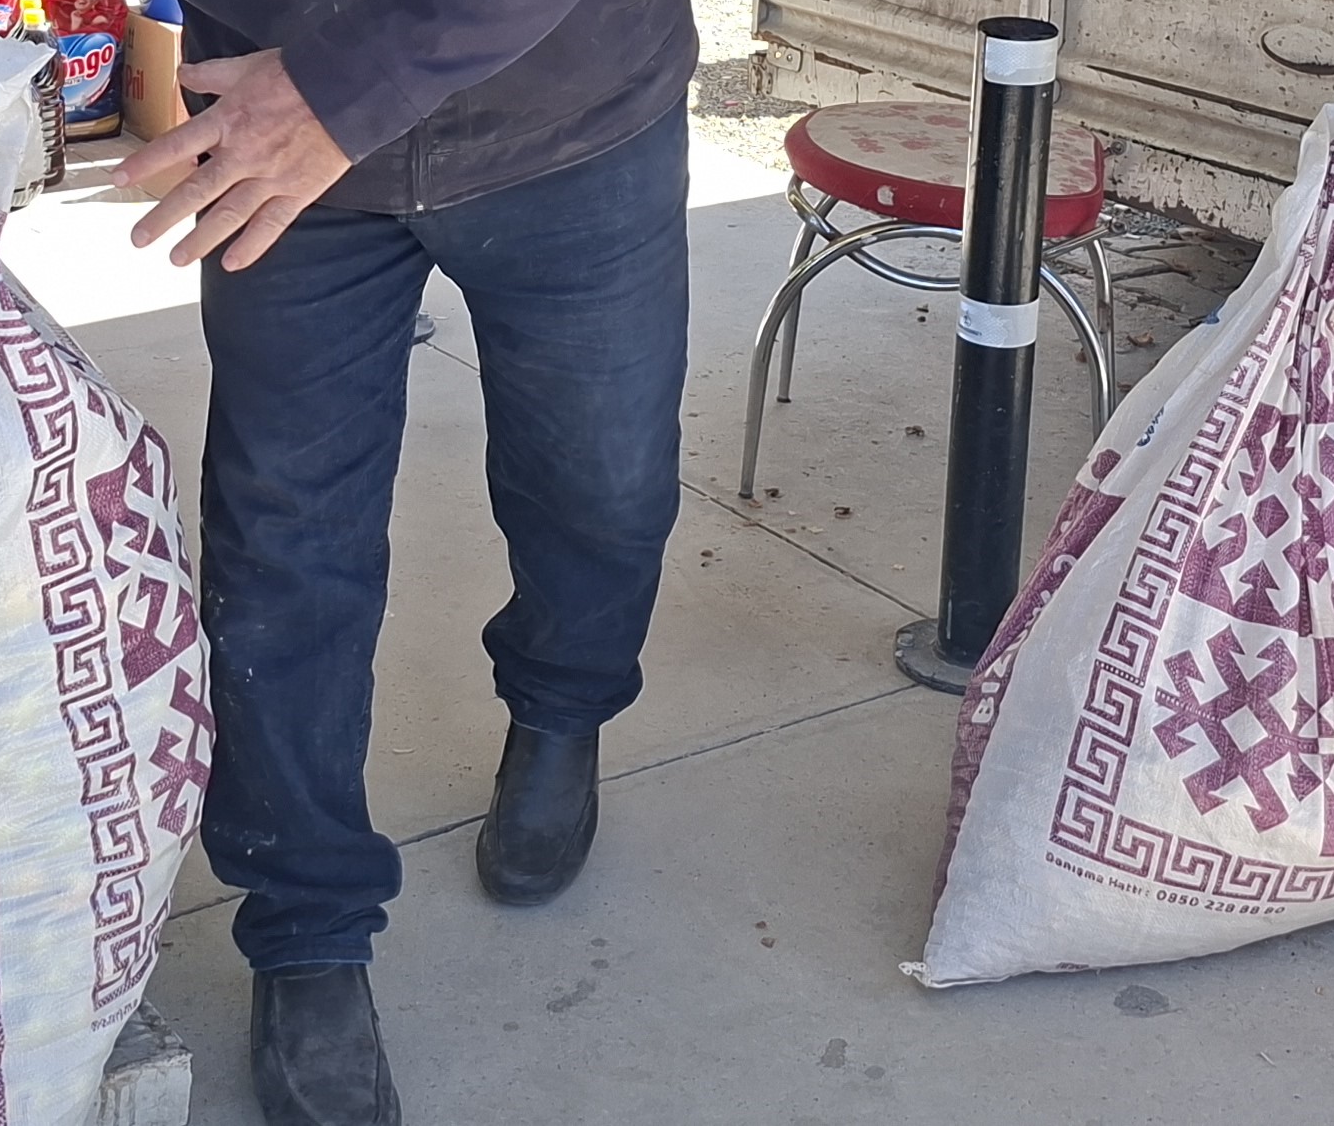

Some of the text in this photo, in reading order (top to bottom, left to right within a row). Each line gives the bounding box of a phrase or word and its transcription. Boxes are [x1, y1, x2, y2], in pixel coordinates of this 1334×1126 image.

[63, 43, 115, 80] ngo
[125, 64, 145, 101] Pril
[1156, 888, 1199, 908] 0850
[1204, 898, 1235, 914] 228
